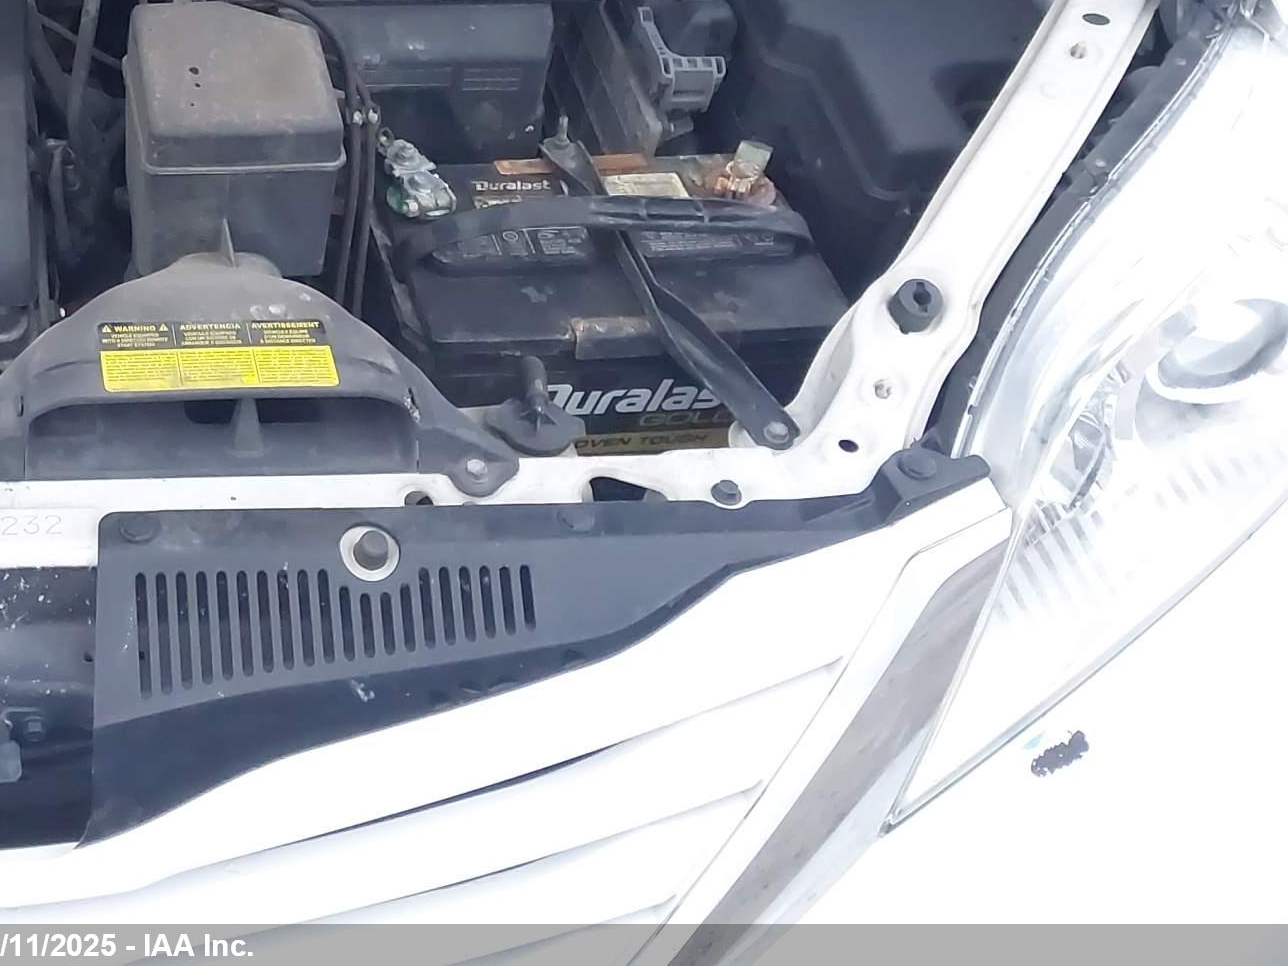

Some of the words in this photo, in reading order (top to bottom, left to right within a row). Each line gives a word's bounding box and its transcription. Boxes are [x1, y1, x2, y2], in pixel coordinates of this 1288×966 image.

[472, 179, 551, 191] Duralast
[113, 325, 157, 333] WARNING
[180, 322, 241, 331] ADVERTENCIA
[251, 321, 320, 330] AVERTISSEMENT
[547, 379, 720, 415] Duralas
[574, 436, 633, 449] OVEN
